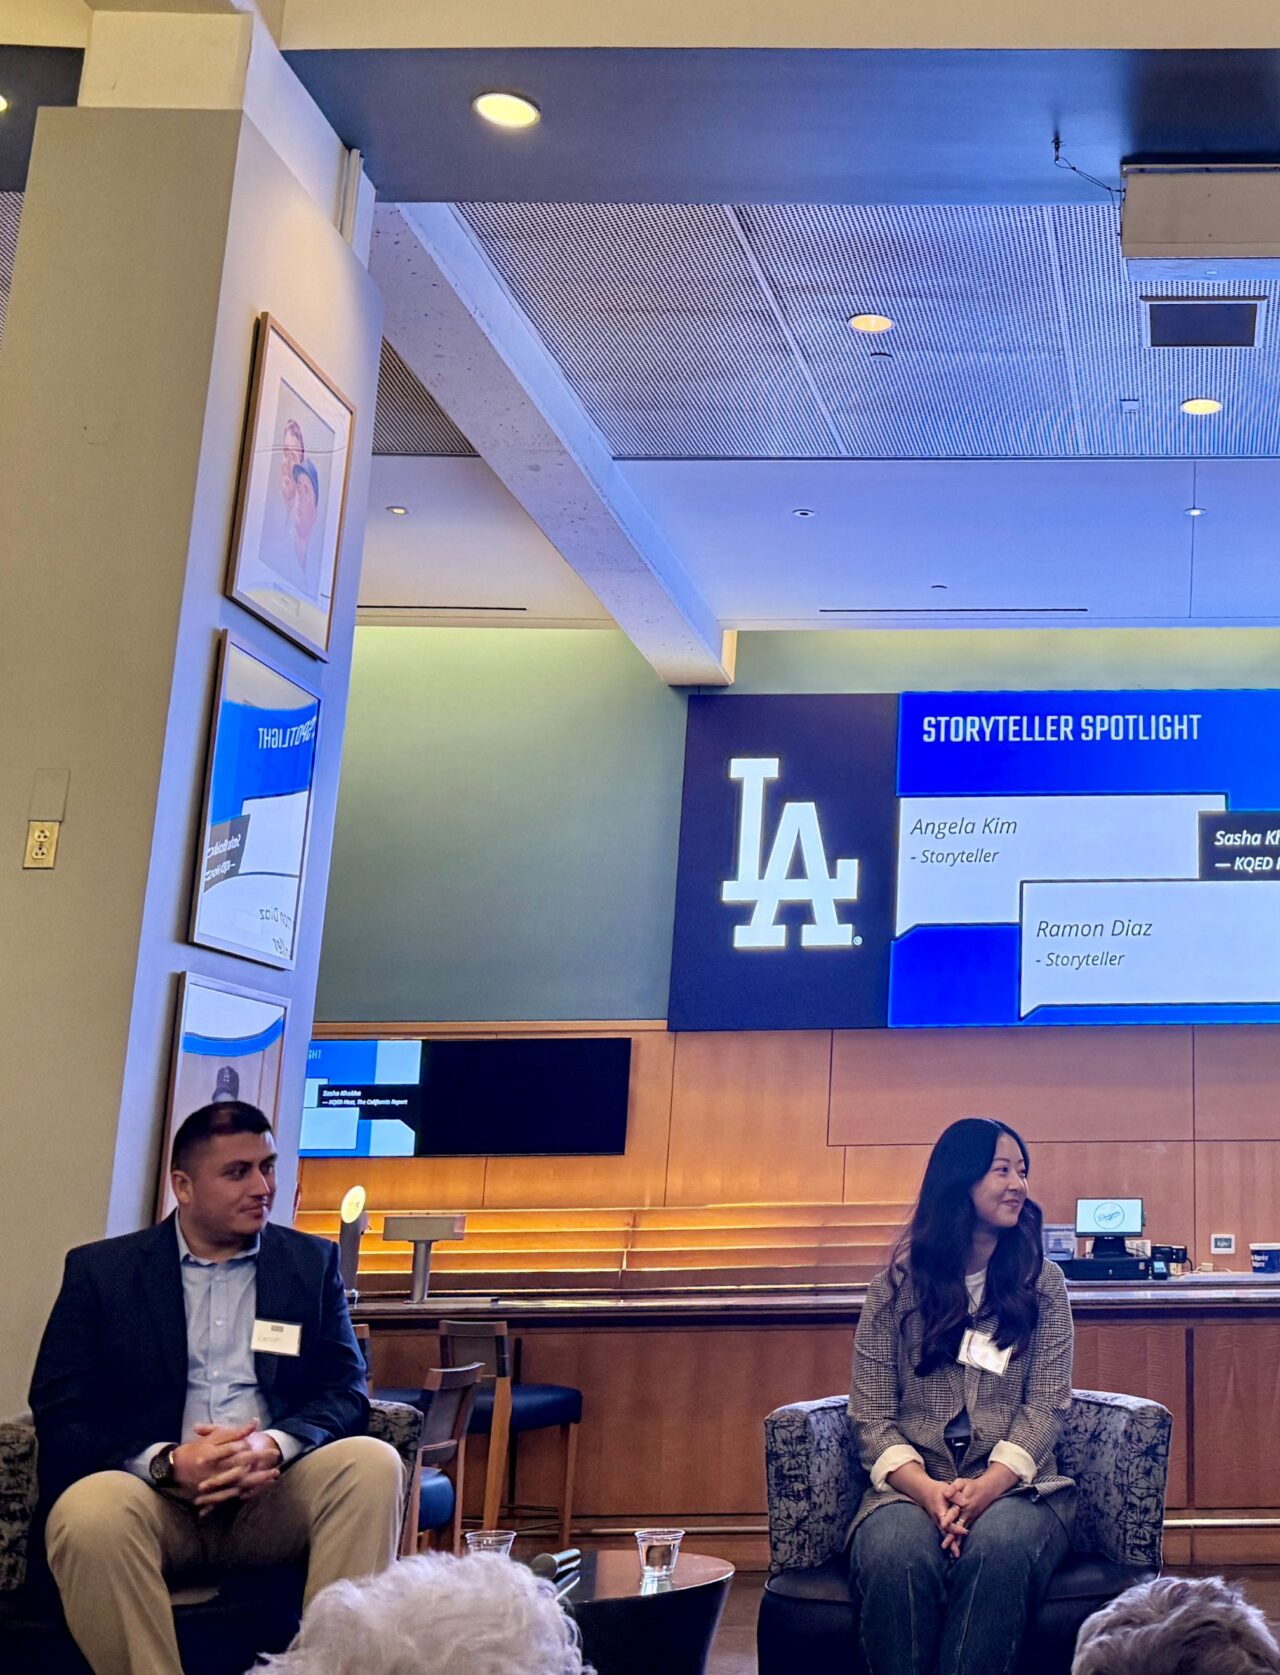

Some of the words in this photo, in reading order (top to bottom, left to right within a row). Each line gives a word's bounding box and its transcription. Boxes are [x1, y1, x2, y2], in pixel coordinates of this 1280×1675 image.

[922, 715, 1074, 742] STORYTELLER
[1080, 714, 1202, 741] SPOTLIGHT
[910, 817, 976, 840] Angela
[981, 816, 1018, 835] Kim
[1214, 830, 1261, 846] Sasha
[722, 757, 859, 947] LA
[920, 848, 999, 867] Storyteller
[1234, 856, 1274, 873] KQED
[1036, 920, 1105, 938] Ramon
[1111, 919, 1153, 937] Diaz
[1045, 951, 1126, 970] Storyteller
